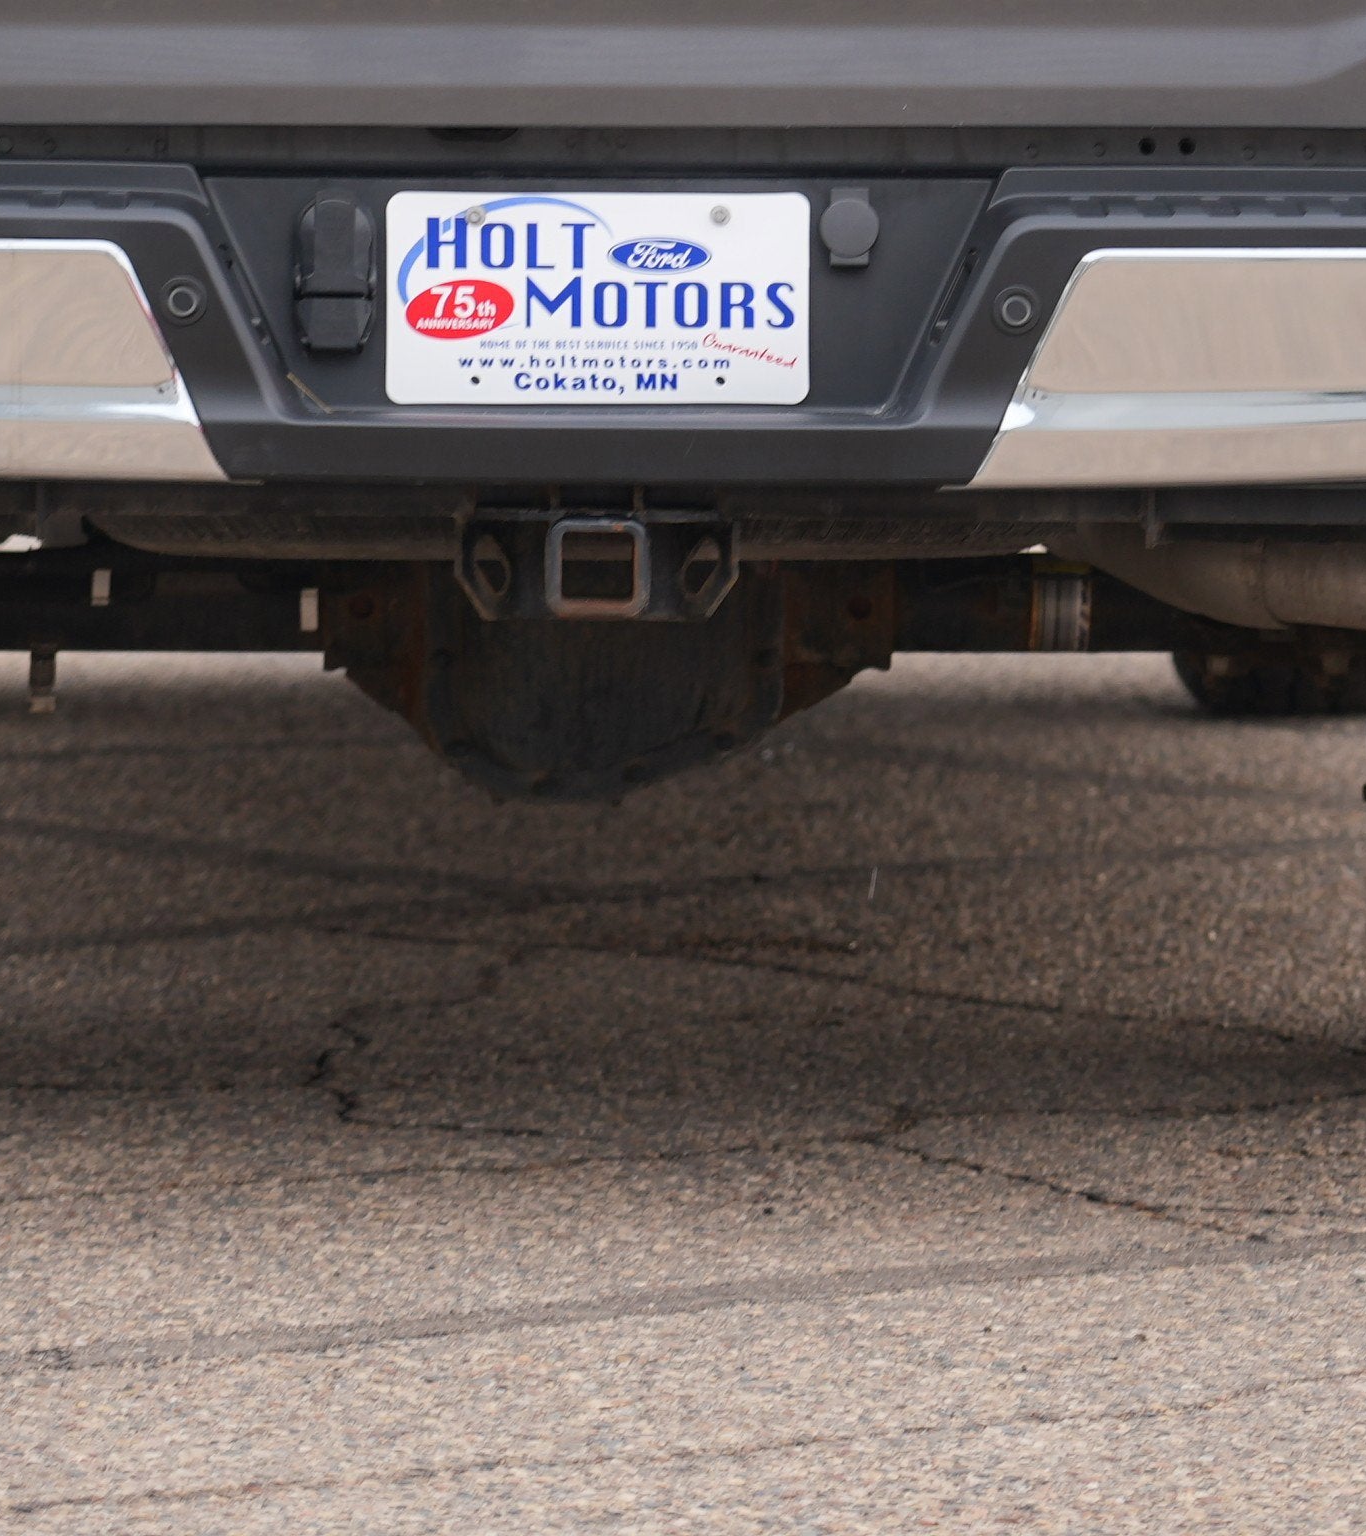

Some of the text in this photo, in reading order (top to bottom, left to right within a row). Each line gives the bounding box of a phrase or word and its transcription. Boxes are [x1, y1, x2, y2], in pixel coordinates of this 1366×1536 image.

[425, 217, 596, 269] HOLT
[626, 241, 693, 269] Ford
[430, 285, 498, 319] 75th
[524, 276, 796, 330] MOTORS
[415, 317, 497, 331] ANNIVERSARY
[479, 340, 511, 350] HOME
[515, 340, 527, 350] OF
[533, 340, 551, 350] THE
[555, 340, 580, 350] BEST
[584, 340, 629, 350] SERVICE
[633, 340, 665, 350] SINCE
[702, 332, 798, 369] Guaranteed
[458, 354, 731, 369] www.holtmotors.com
[513, 372, 678, 395] Cokato, MN
